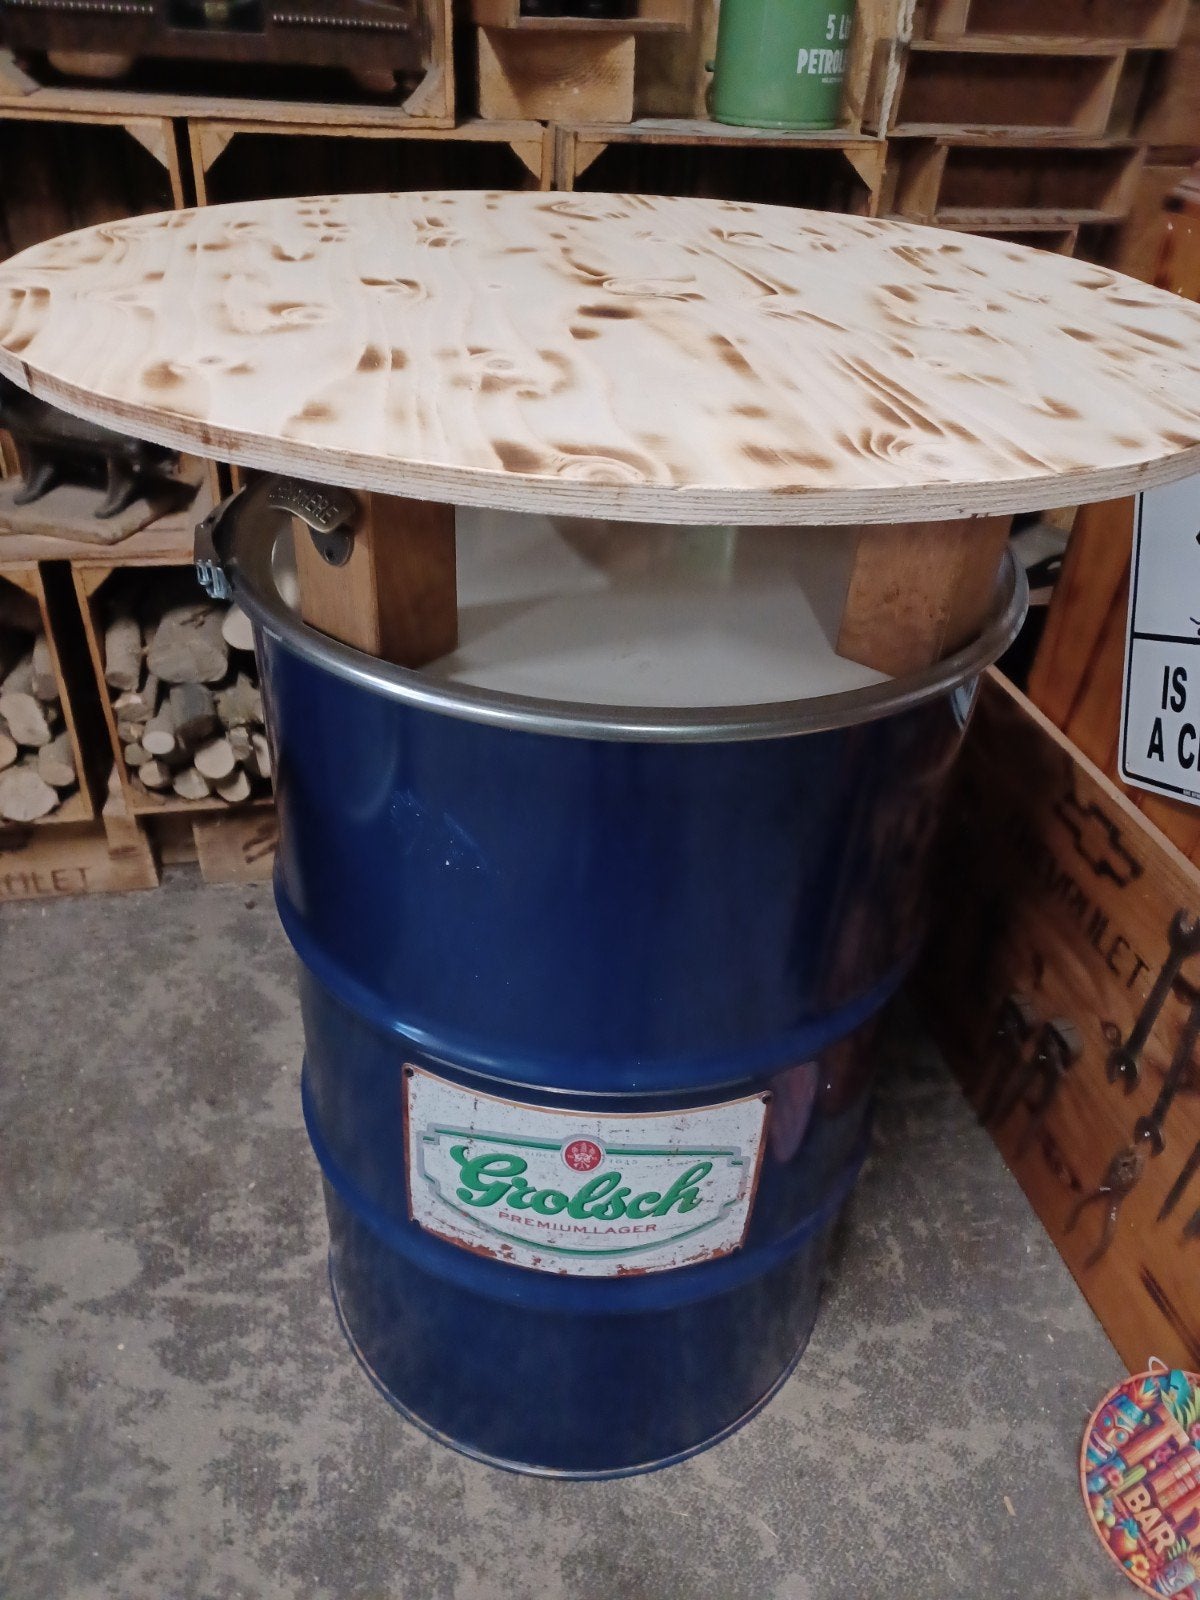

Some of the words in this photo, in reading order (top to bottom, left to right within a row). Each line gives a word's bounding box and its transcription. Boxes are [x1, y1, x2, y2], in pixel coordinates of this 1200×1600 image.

[826, 13, 837, 40] 5
[797, 48, 848, 74] PETROL
[1161, 665, 1188, 713] IS
[1146, 717, 1165, 762] A
[1177, 722, 1200, 772] C
[450, 1144, 713, 1221] Grolsch
[498, 1211, 587, 1233] PREMIUM
[593, 1224, 657, 1234] LAGER
[1123, 1483, 1177, 1555] BAR
